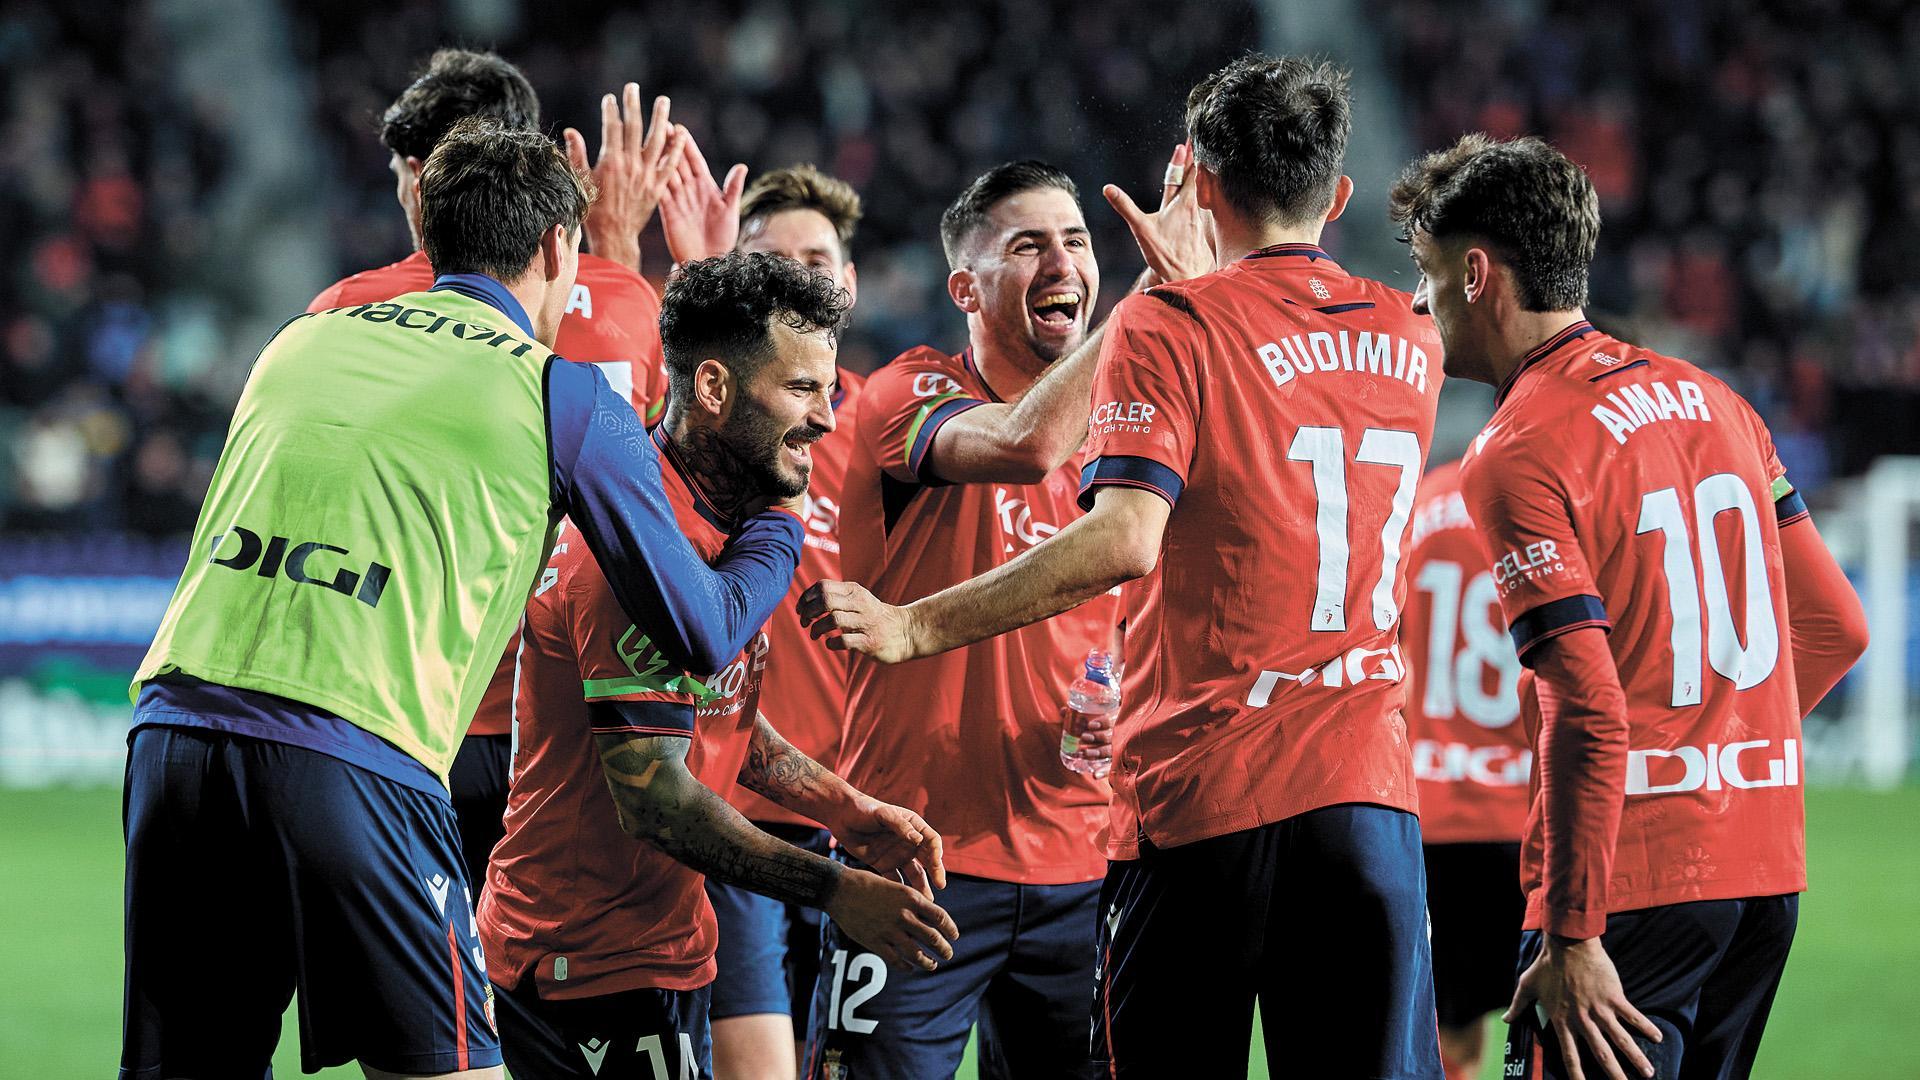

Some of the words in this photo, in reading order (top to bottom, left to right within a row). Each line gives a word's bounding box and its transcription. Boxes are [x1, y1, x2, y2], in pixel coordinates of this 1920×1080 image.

[1257, 331, 1428, 393] BUDIMIR
[1592, 381, 1712, 444] AIMAR
[208, 524, 392, 609] DIGI
[1286, 426, 1422, 631] 17
[1637, 474, 1780, 707] 10
[1415, 560, 1520, 728] 18
[1625, 738, 1799, 796] DIGI
[828, 949, 888, 1035] 12
